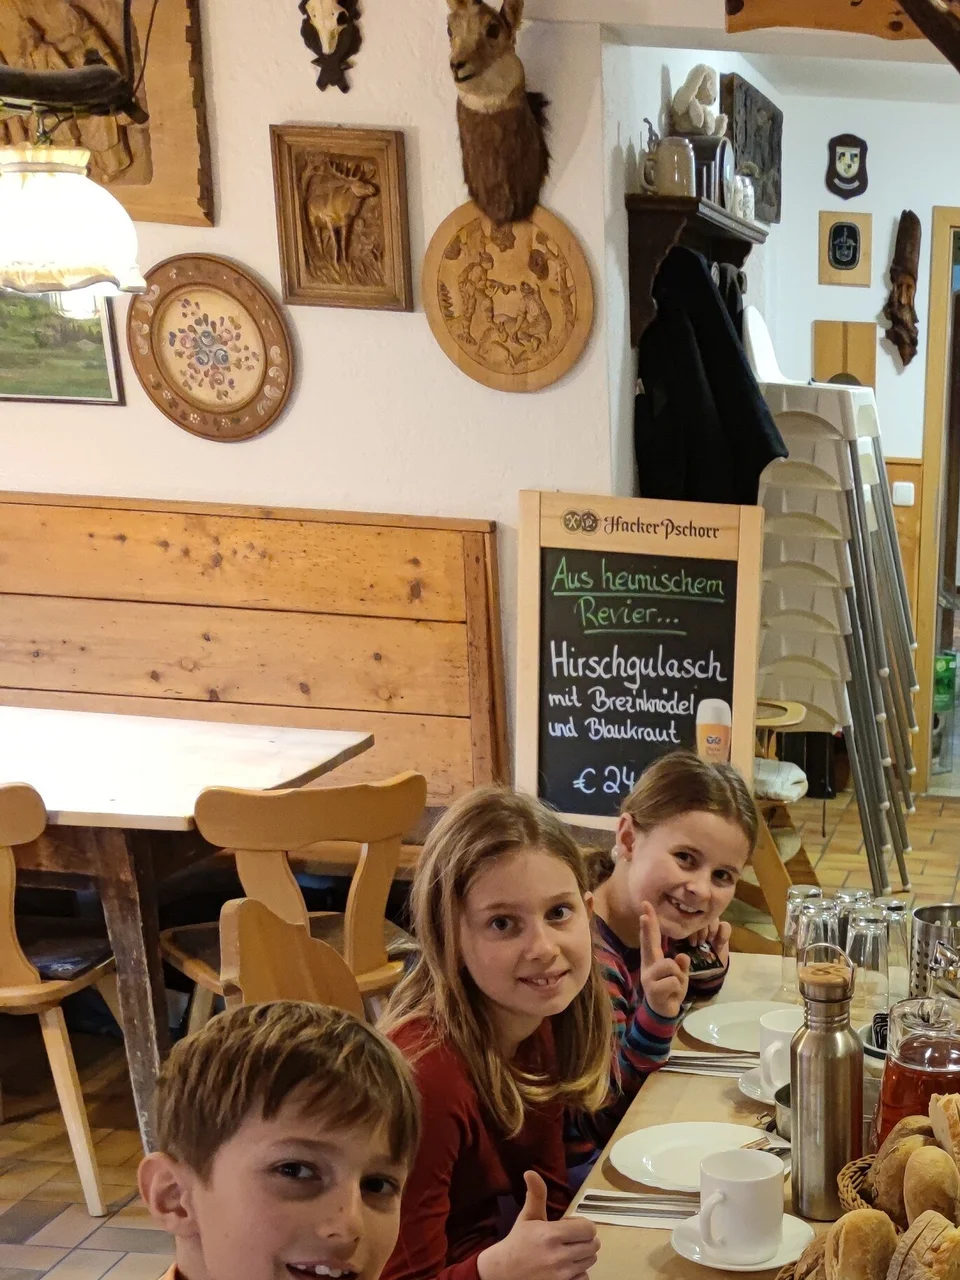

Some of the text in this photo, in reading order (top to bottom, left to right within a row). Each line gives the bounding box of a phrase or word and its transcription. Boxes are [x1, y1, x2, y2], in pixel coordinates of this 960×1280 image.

[551, 556, 725, 595] Aus heimischem
[550, 640, 728, 689] Hirschgulasch
[548, 685, 582, 707] mit
[548, 716, 681, 743] und Blaukraut
